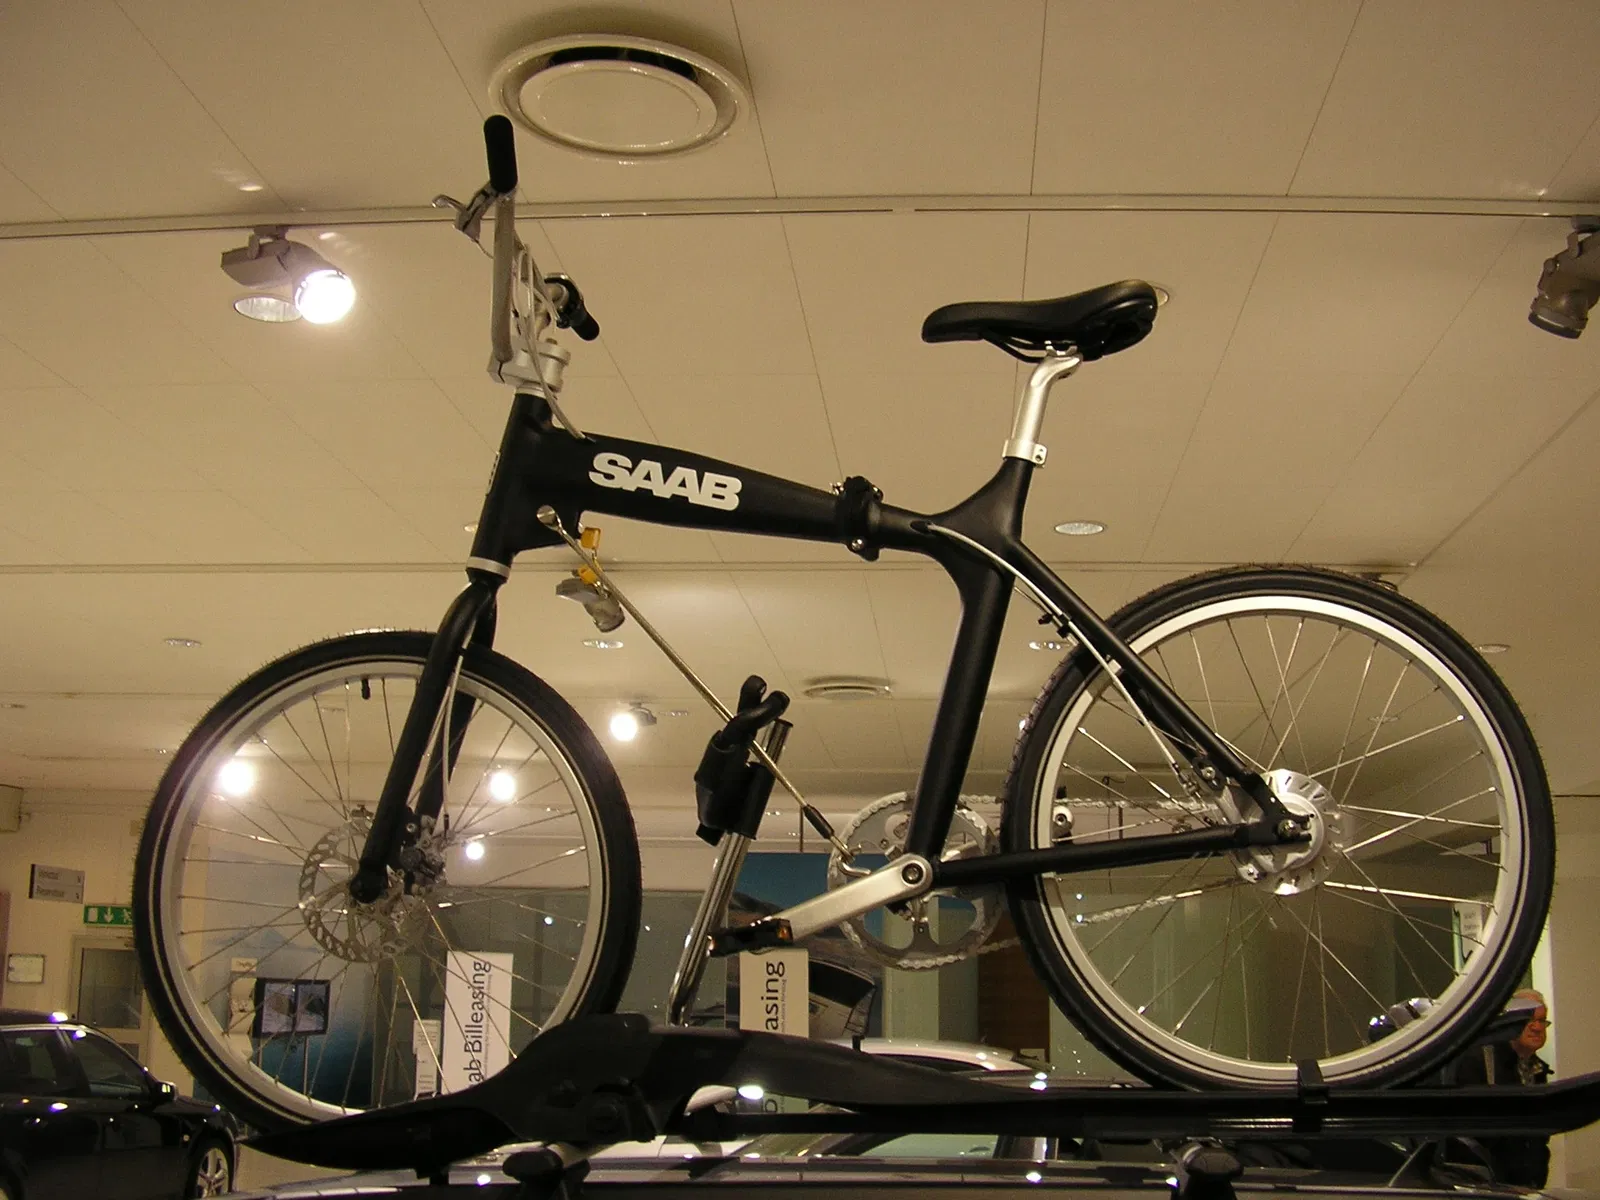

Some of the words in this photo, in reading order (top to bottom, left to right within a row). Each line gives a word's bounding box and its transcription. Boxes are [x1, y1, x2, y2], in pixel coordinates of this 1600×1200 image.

[588, 452, 742, 511] SAAB
[464, 961, 491, 1053] Billeasing
[761, 961, 785, 1030] asing
[463, 1059, 483, 1086] ab
